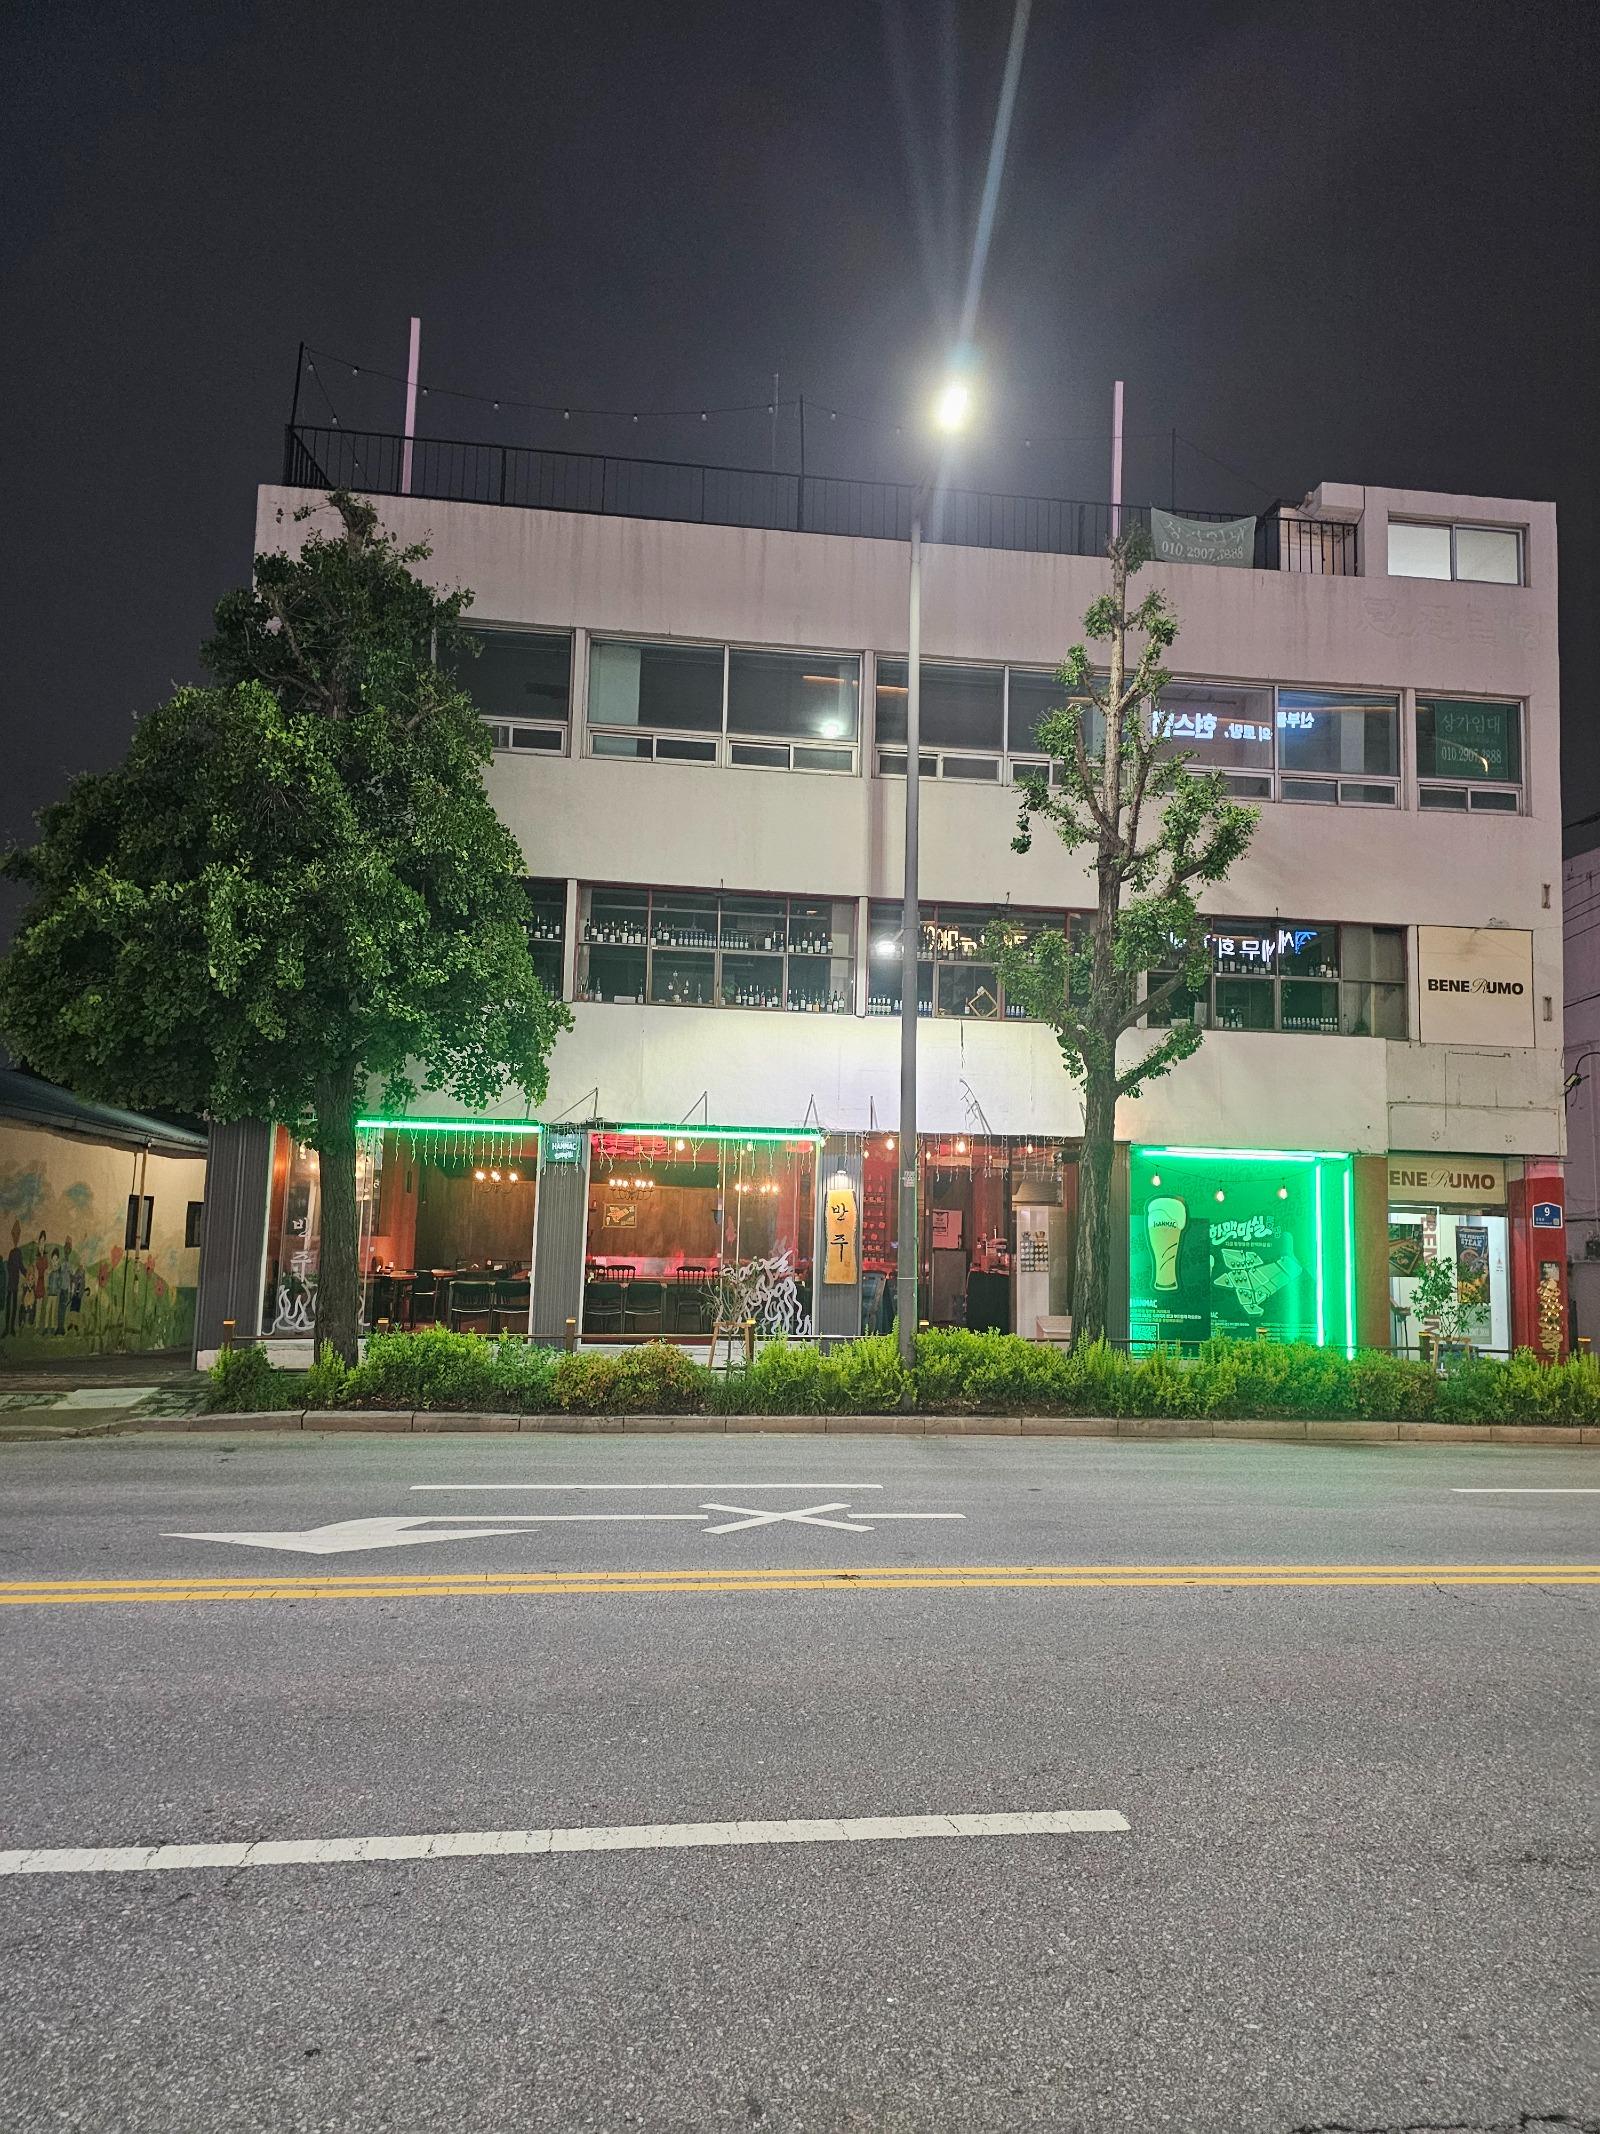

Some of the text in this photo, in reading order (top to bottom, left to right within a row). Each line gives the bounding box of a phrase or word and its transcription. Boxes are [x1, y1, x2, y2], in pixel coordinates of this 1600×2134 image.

[1428, 978, 1524, 995] BENE RUMO
[1389, 1168, 1496, 1190] ENE RUMO
[1544, 1206, 1551, 1217] 9
